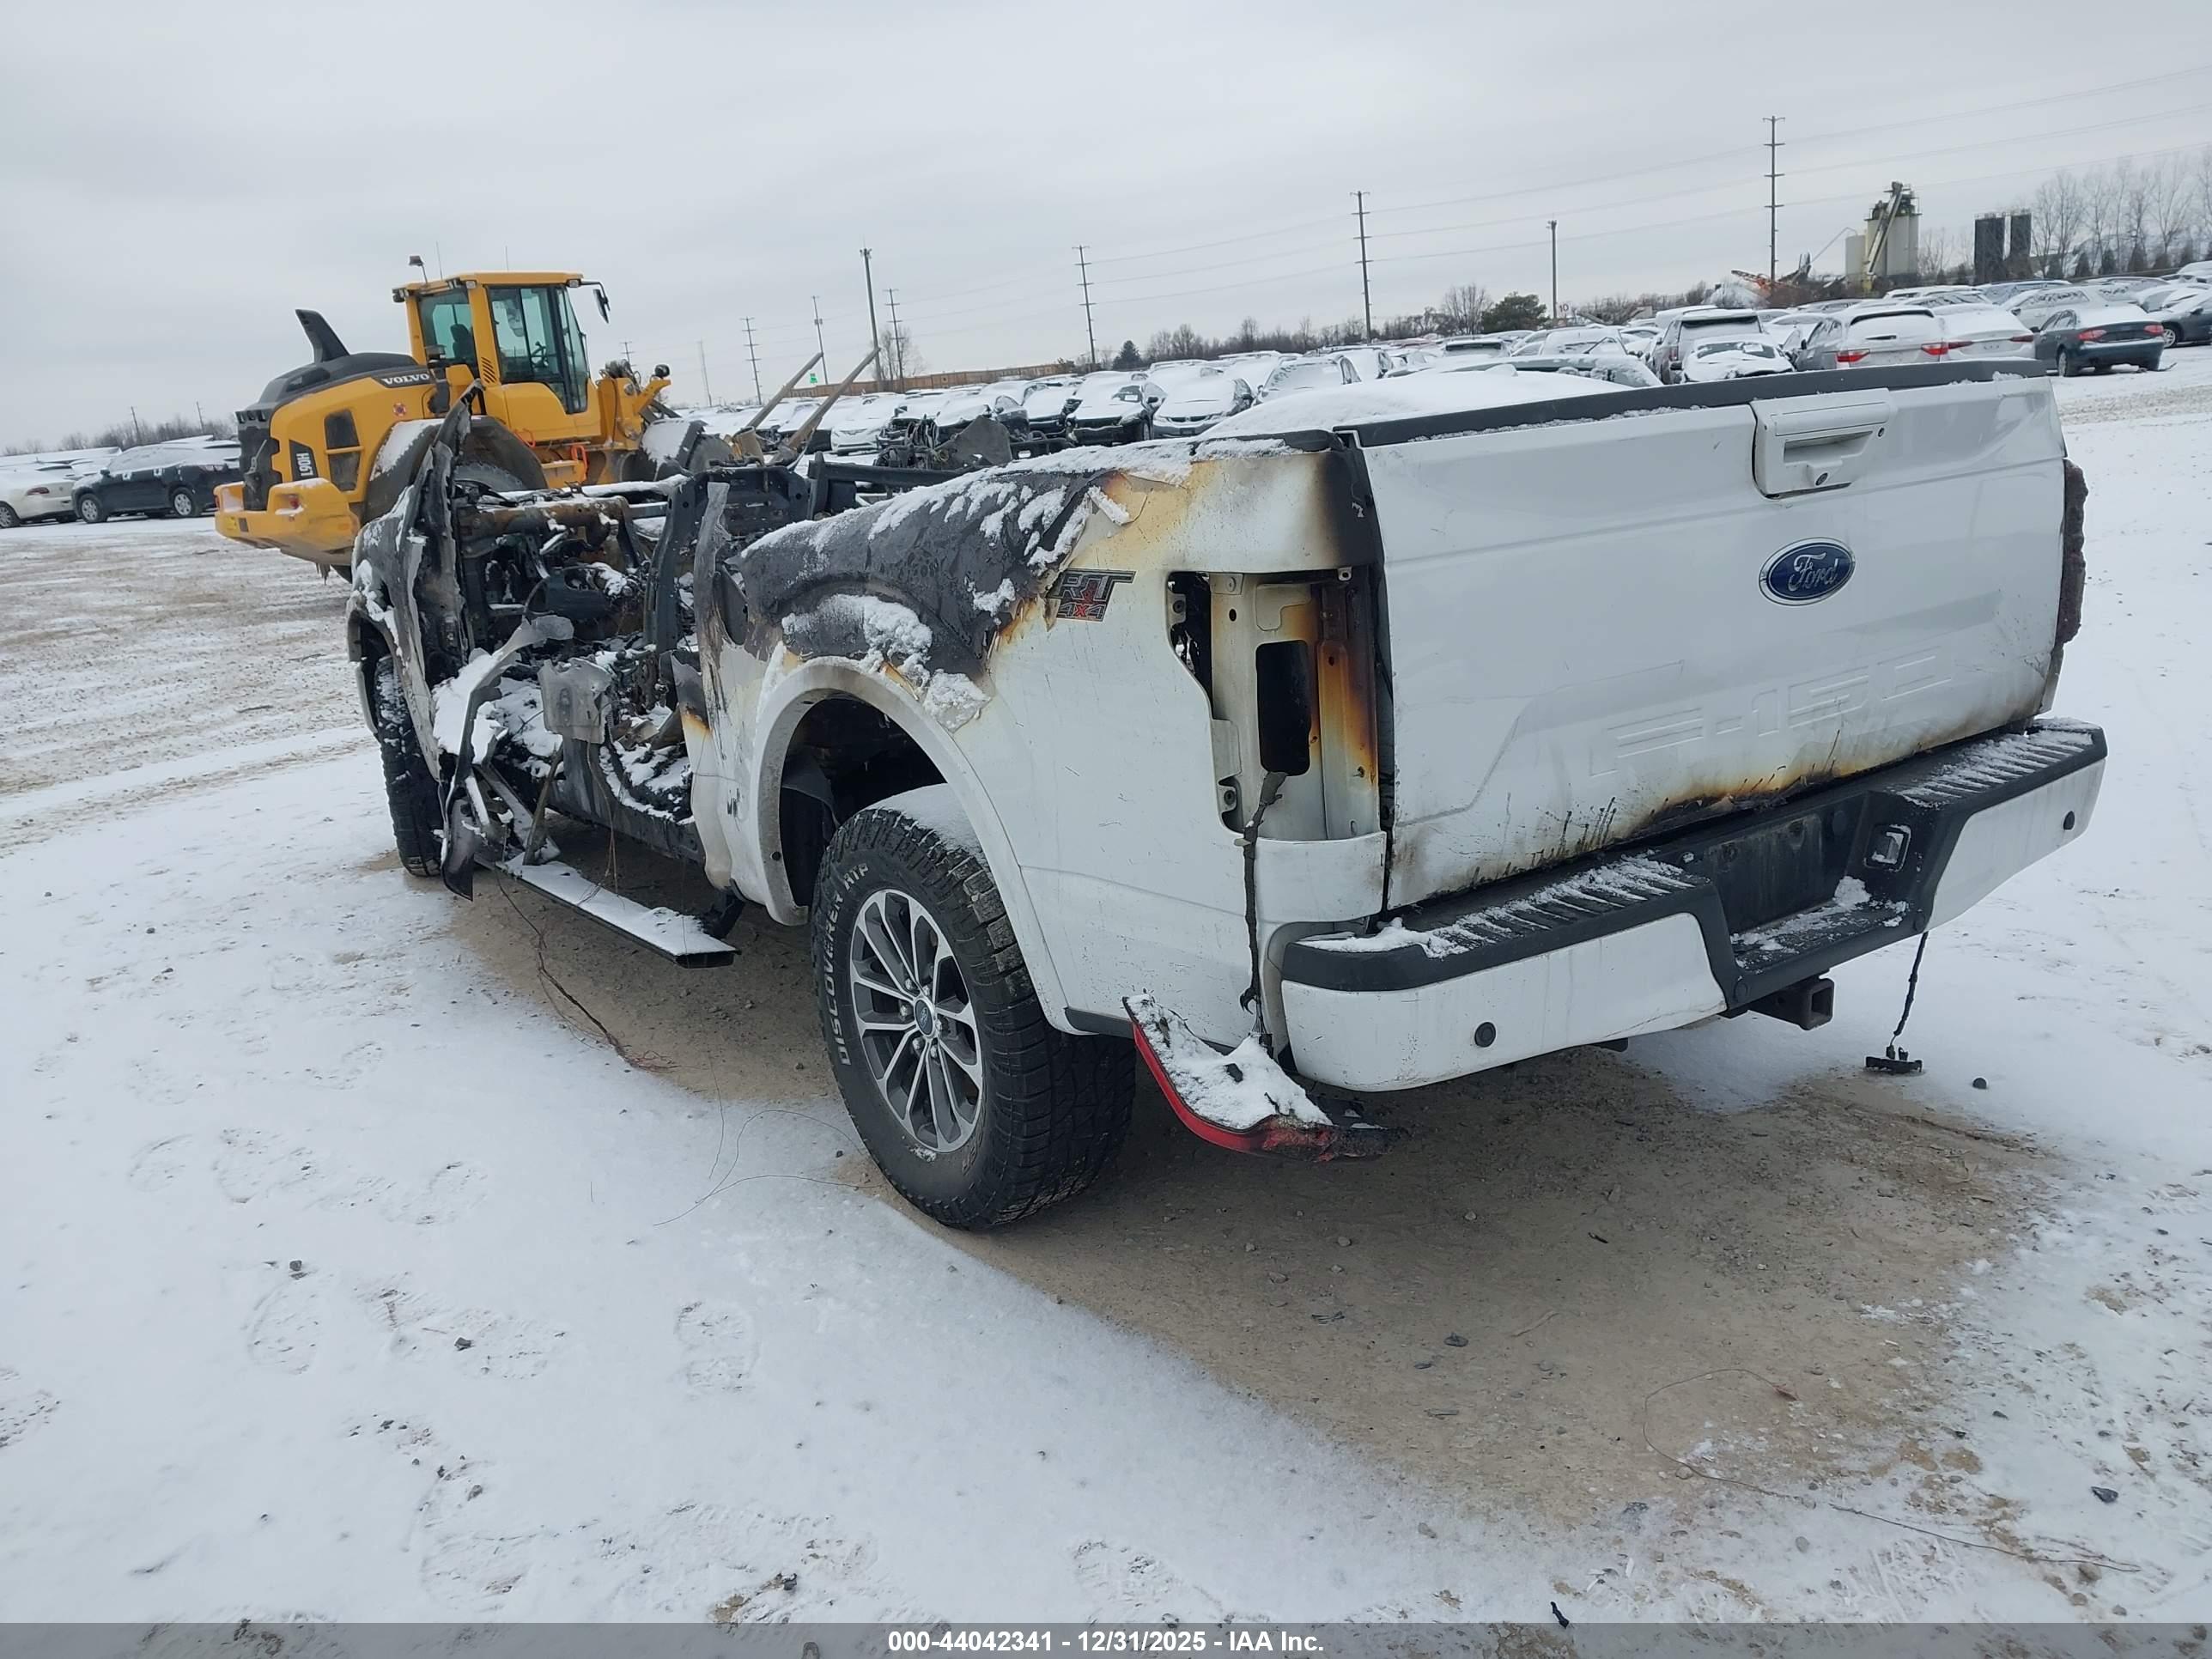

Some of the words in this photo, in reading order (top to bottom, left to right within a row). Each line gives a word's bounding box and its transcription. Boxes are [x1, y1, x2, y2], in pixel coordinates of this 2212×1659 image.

[381, 373, 430, 385] VOLVO
[296, 453, 314, 477] L90H
[1788, 551, 1839, 592] Ford
[823, 891, 851, 1066] DISCOVERER
